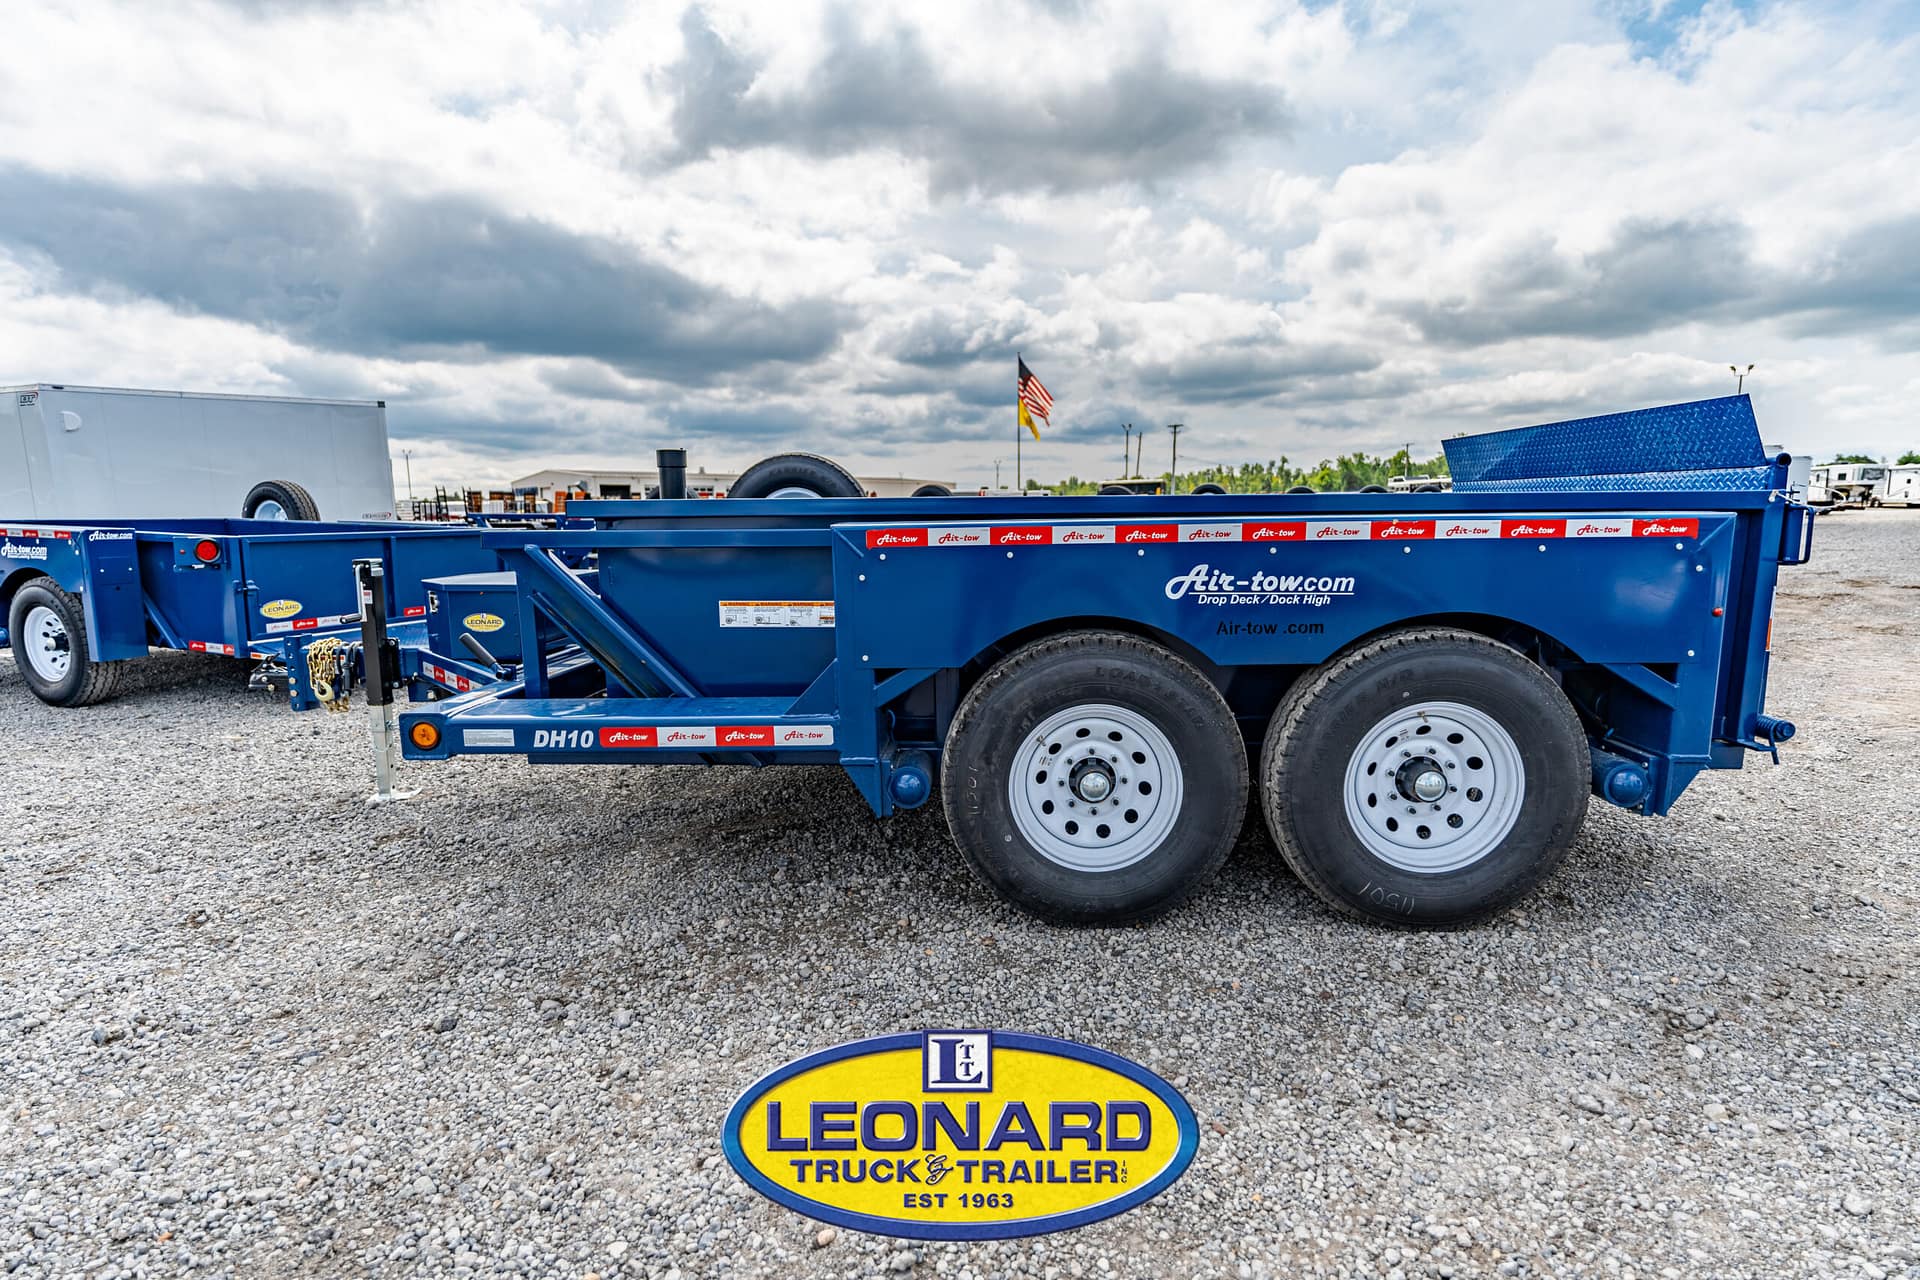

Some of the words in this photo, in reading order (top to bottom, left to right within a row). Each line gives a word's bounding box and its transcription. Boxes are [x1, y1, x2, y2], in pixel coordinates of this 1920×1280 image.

[877, 534, 918, 545] Air-tow
[938, 533, 980, 544] Air-tow
[1000, 532, 1042, 543] Air-tow
[1063, 532, 1105, 542] Air-tow
[1126, 530, 1168, 541] Air-tow
[1189, 529, 1231, 540] Air-tow
[1253, 528, 1295, 539] Air-tow
[1317, 527, 1360, 538] Air-tow
[1381, 526, 1424, 537] Air-tow
[1446, 525, 1489, 536] Air-tow
[1511, 525, 1555, 536] Air-tow
[1577, 525, 1620, 535] Air-tow
[1643, 524, 1687, 535] Air-tow
[1165, 564, 1355, 600] Air-tow.com
[1198, 594, 1227, 607] Drop
[1302, 594, 1331, 607] High
[533, 729, 594, 748] DH10
[609, 732, 648, 743] Air-tow
[667, 732, 706, 742] Air-tow
[725, 731, 765, 742] Air-tow
[784, 731, 823, 741] Air-tow
